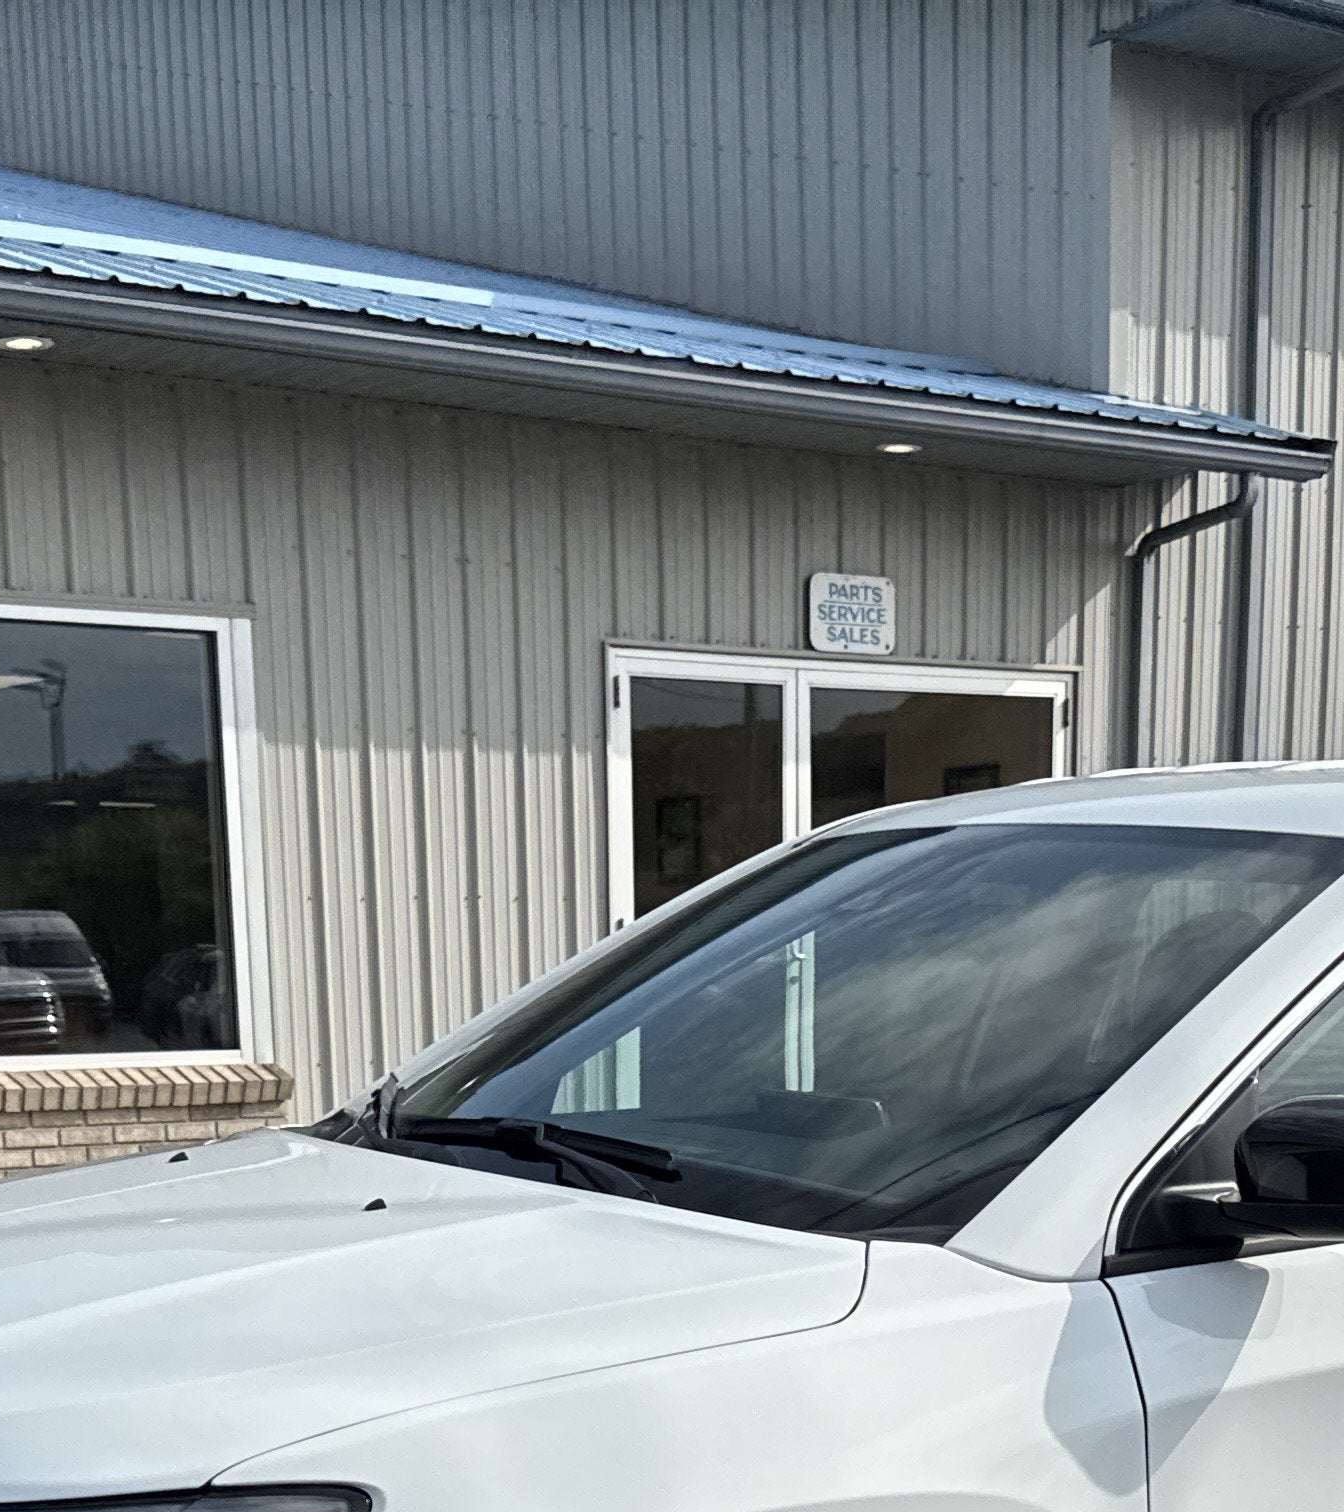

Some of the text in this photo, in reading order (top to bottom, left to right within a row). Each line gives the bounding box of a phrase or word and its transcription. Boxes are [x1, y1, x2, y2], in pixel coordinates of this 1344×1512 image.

[827, 582, 882, 603] PARTS
[817, 603, 888, 625] SERVICE
[826, 625, 881, 645] SALES
